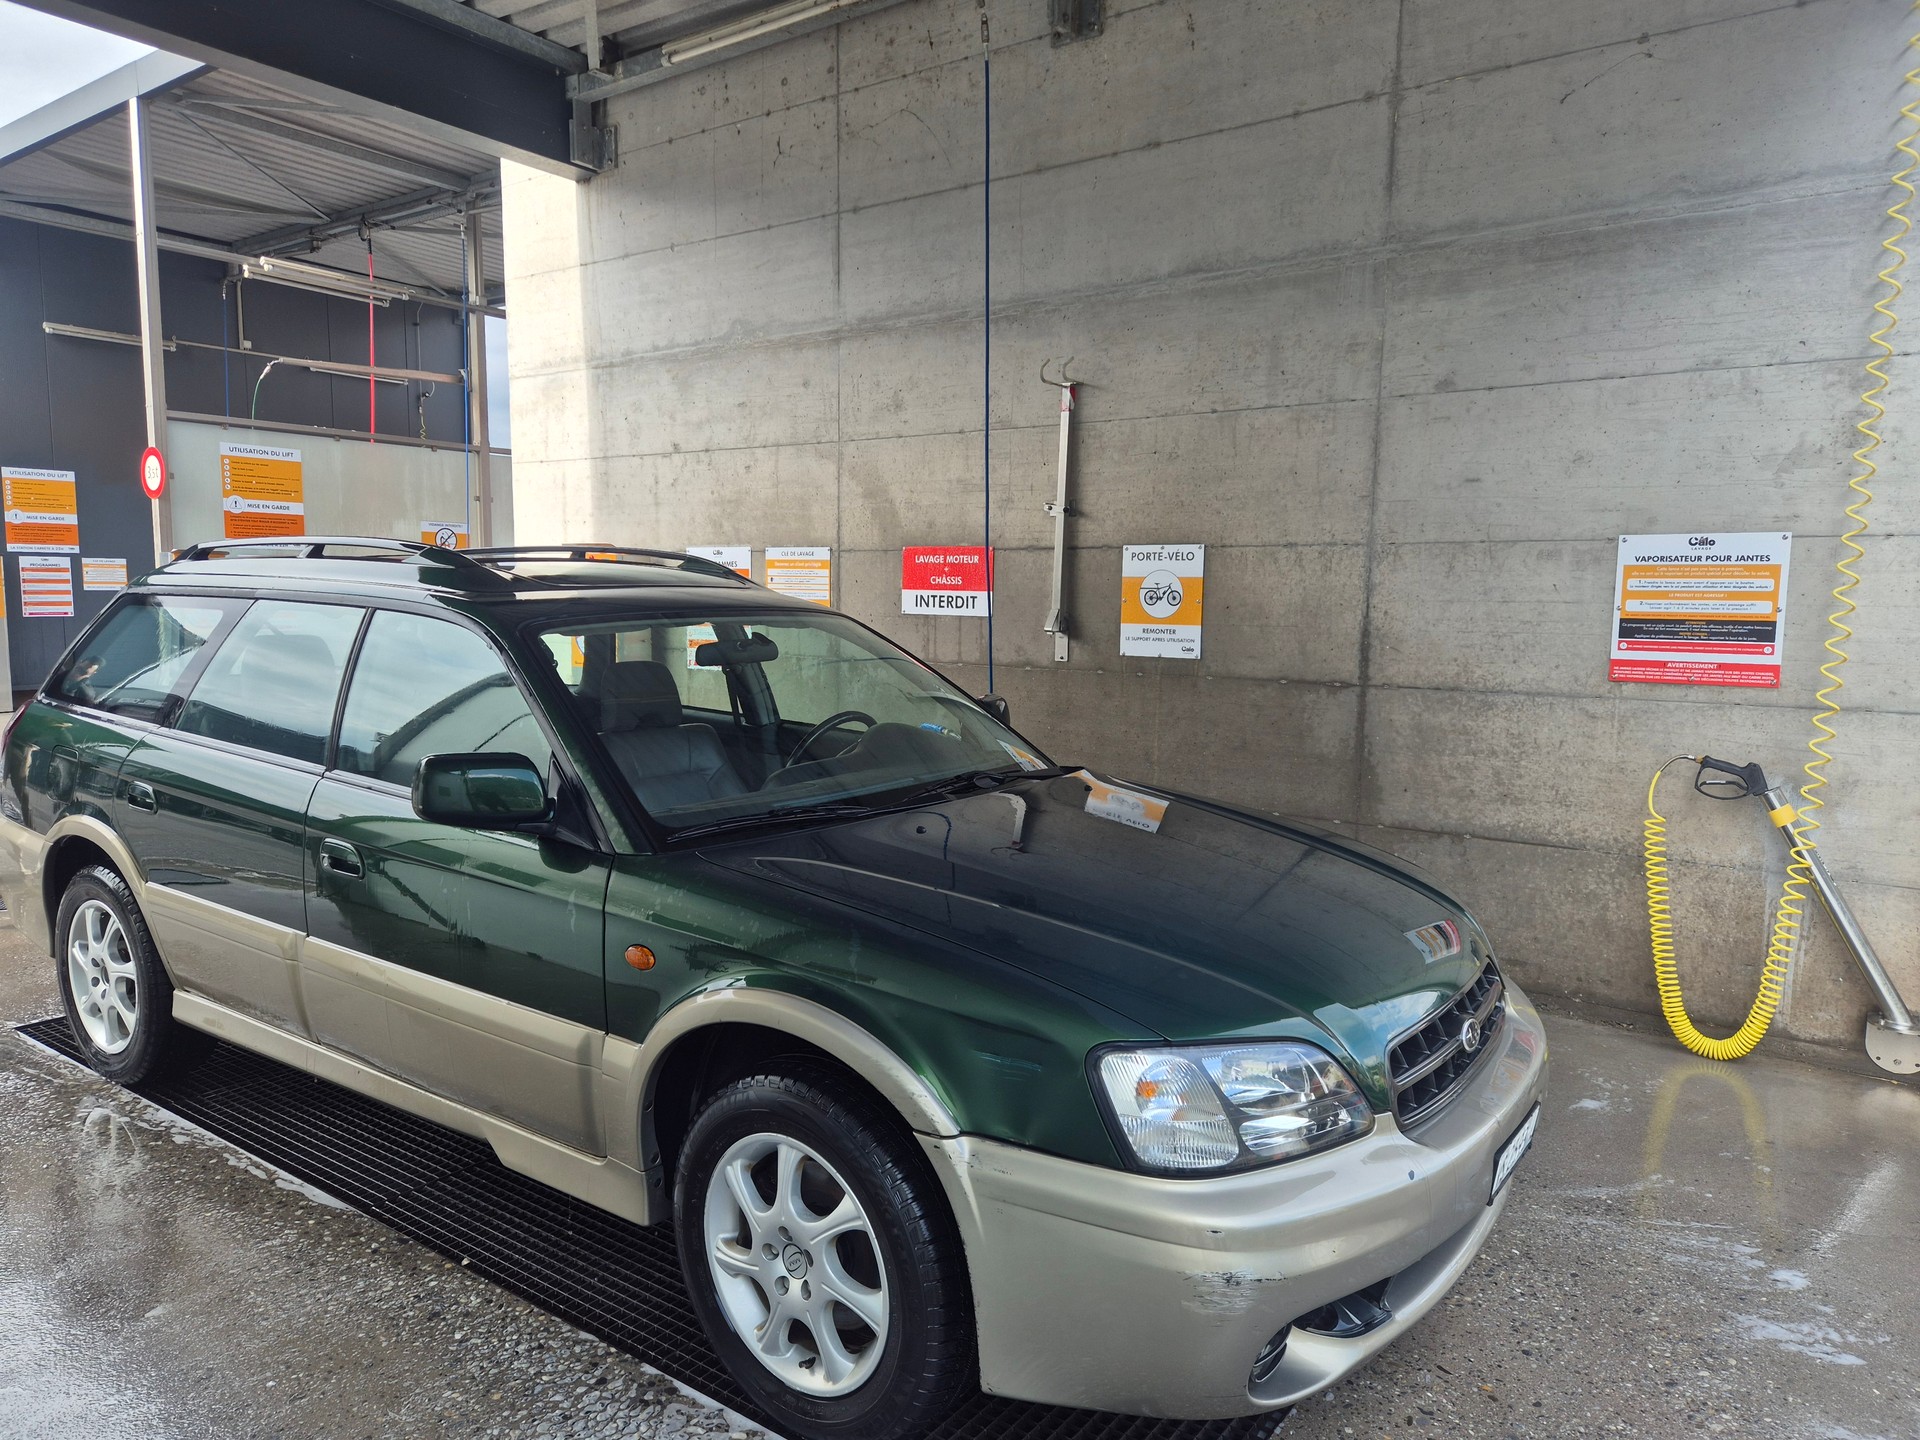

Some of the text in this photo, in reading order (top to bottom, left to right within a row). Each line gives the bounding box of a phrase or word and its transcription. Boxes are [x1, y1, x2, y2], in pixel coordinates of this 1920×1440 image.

[228, 446, 269, 456] UTILISATION
[915, 555, 979, 564] LAVAGE MOTEUR
[1131, 548, 1195, 561] PORTE-VÉLO
[1634, 554, 1771, 563] VAPORISATEUR POUR JANTES
[930, 574, 963, 585] CHÂSSIS
[915, 594, 978, 609] INTERDIT
[1142, 627, 1177, 635] REMONTER
